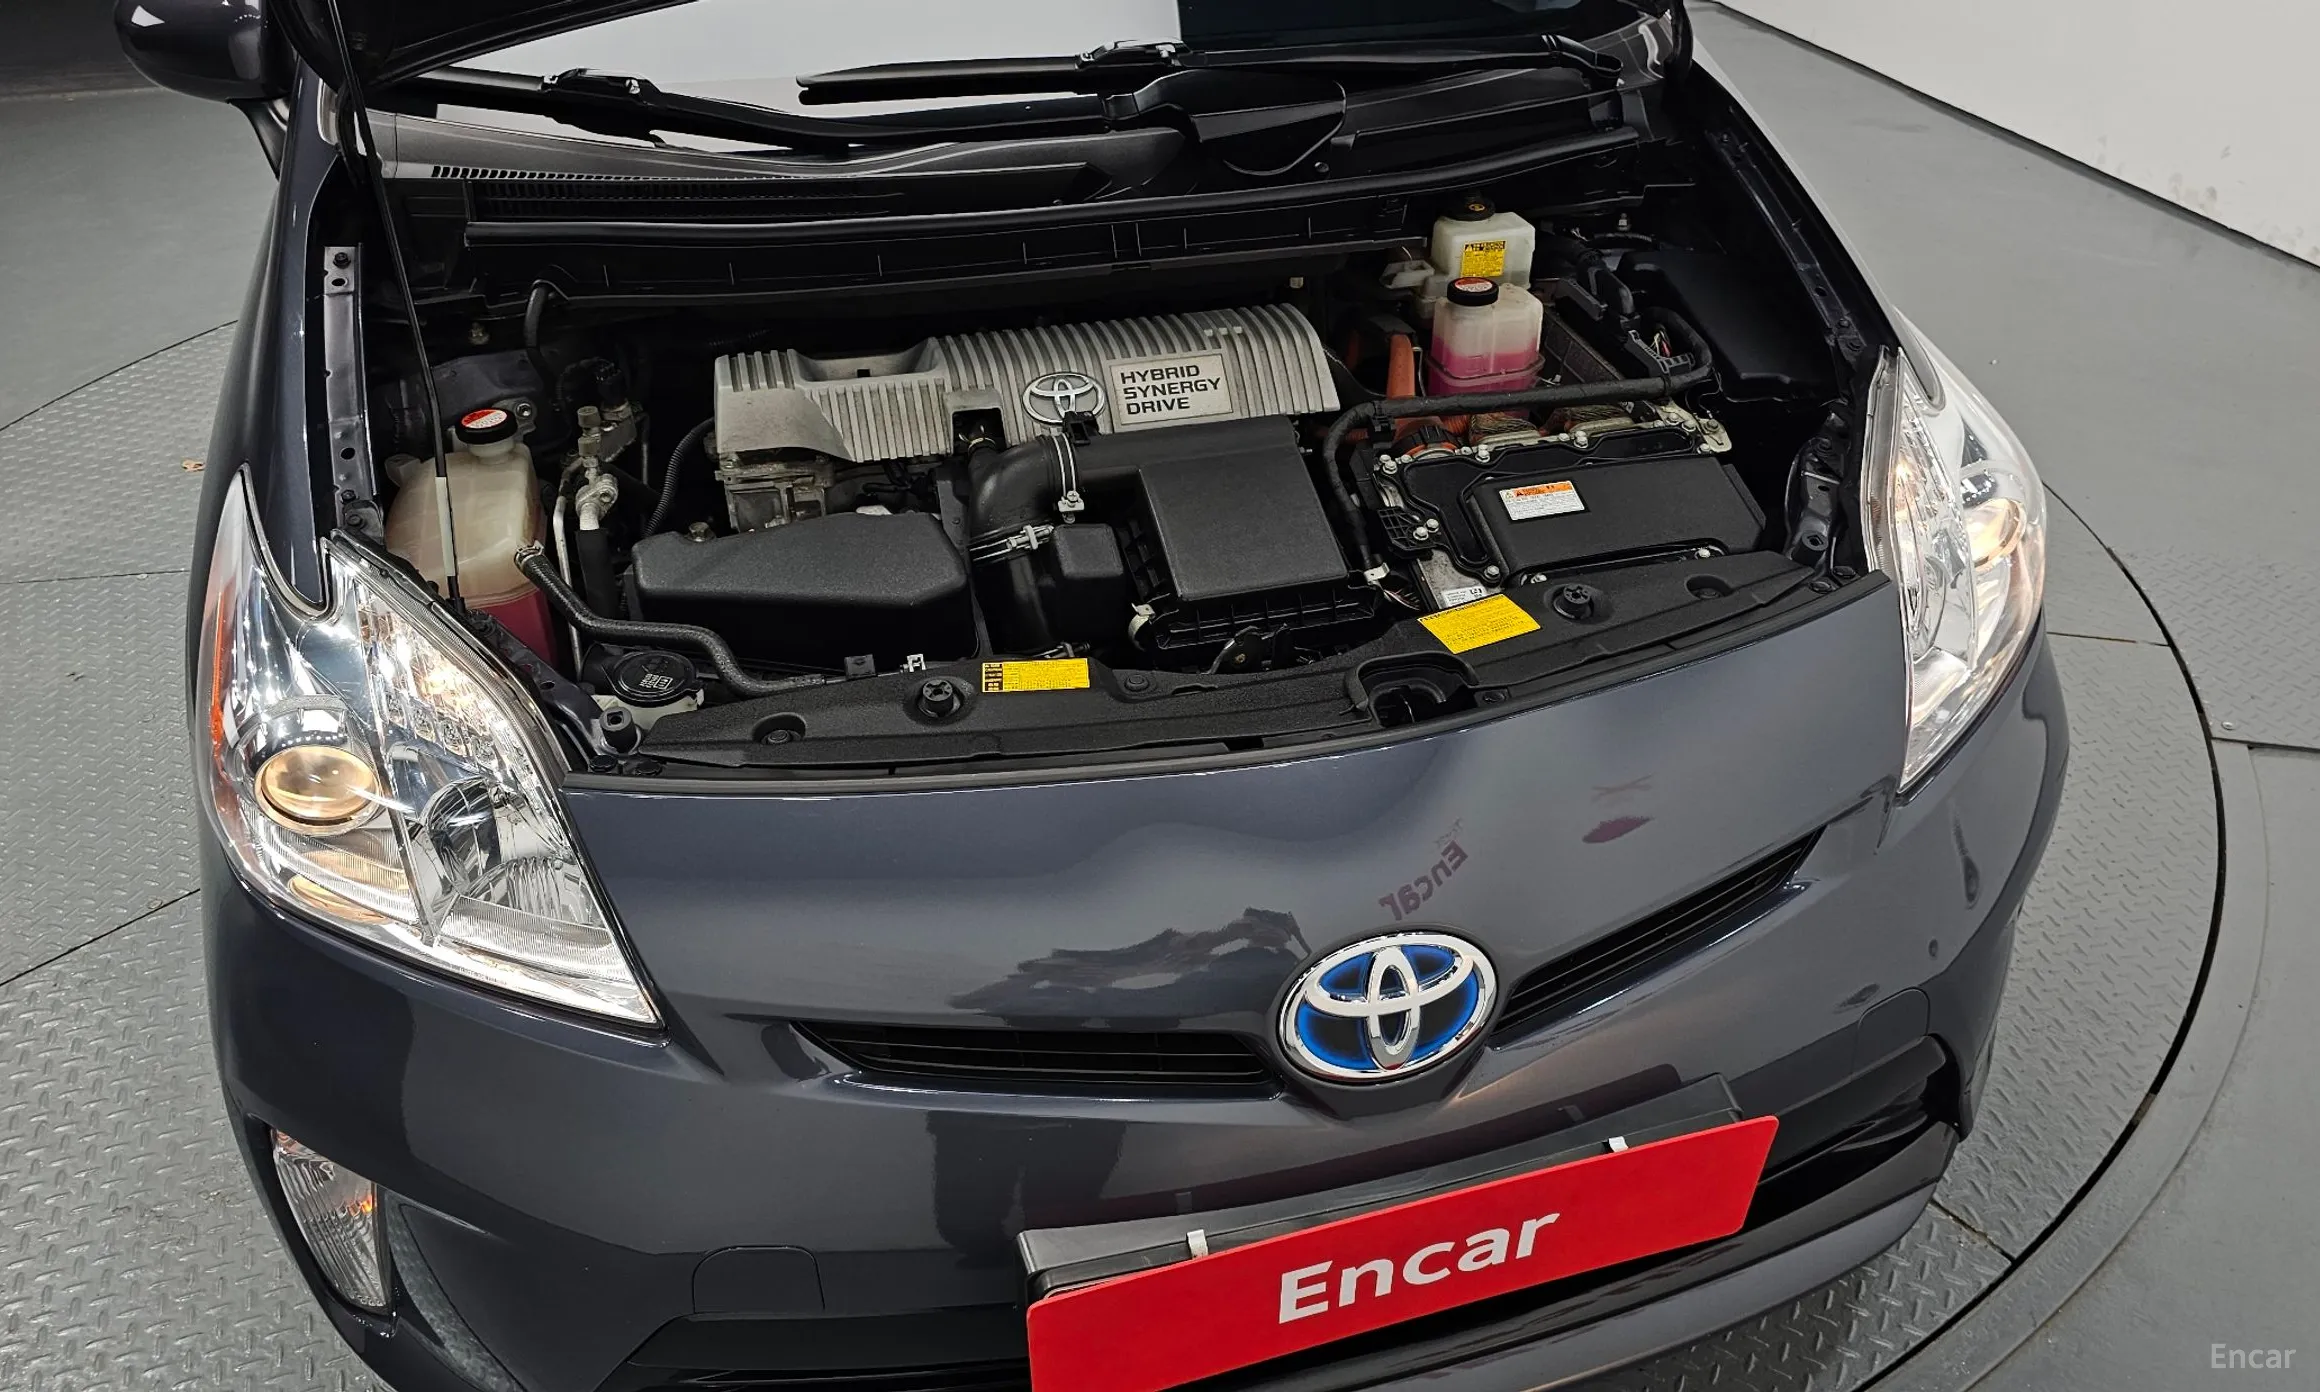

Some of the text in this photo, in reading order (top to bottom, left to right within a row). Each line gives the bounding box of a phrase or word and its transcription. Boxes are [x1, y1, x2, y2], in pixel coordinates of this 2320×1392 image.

[1120, 365, 1200, 385] HYBRID
[1123, 377, 1221, 400] SYNERGY
[1126, 397, 1191, 415] DRIVE
[1279, 1213, 1560, 1324] Encar
